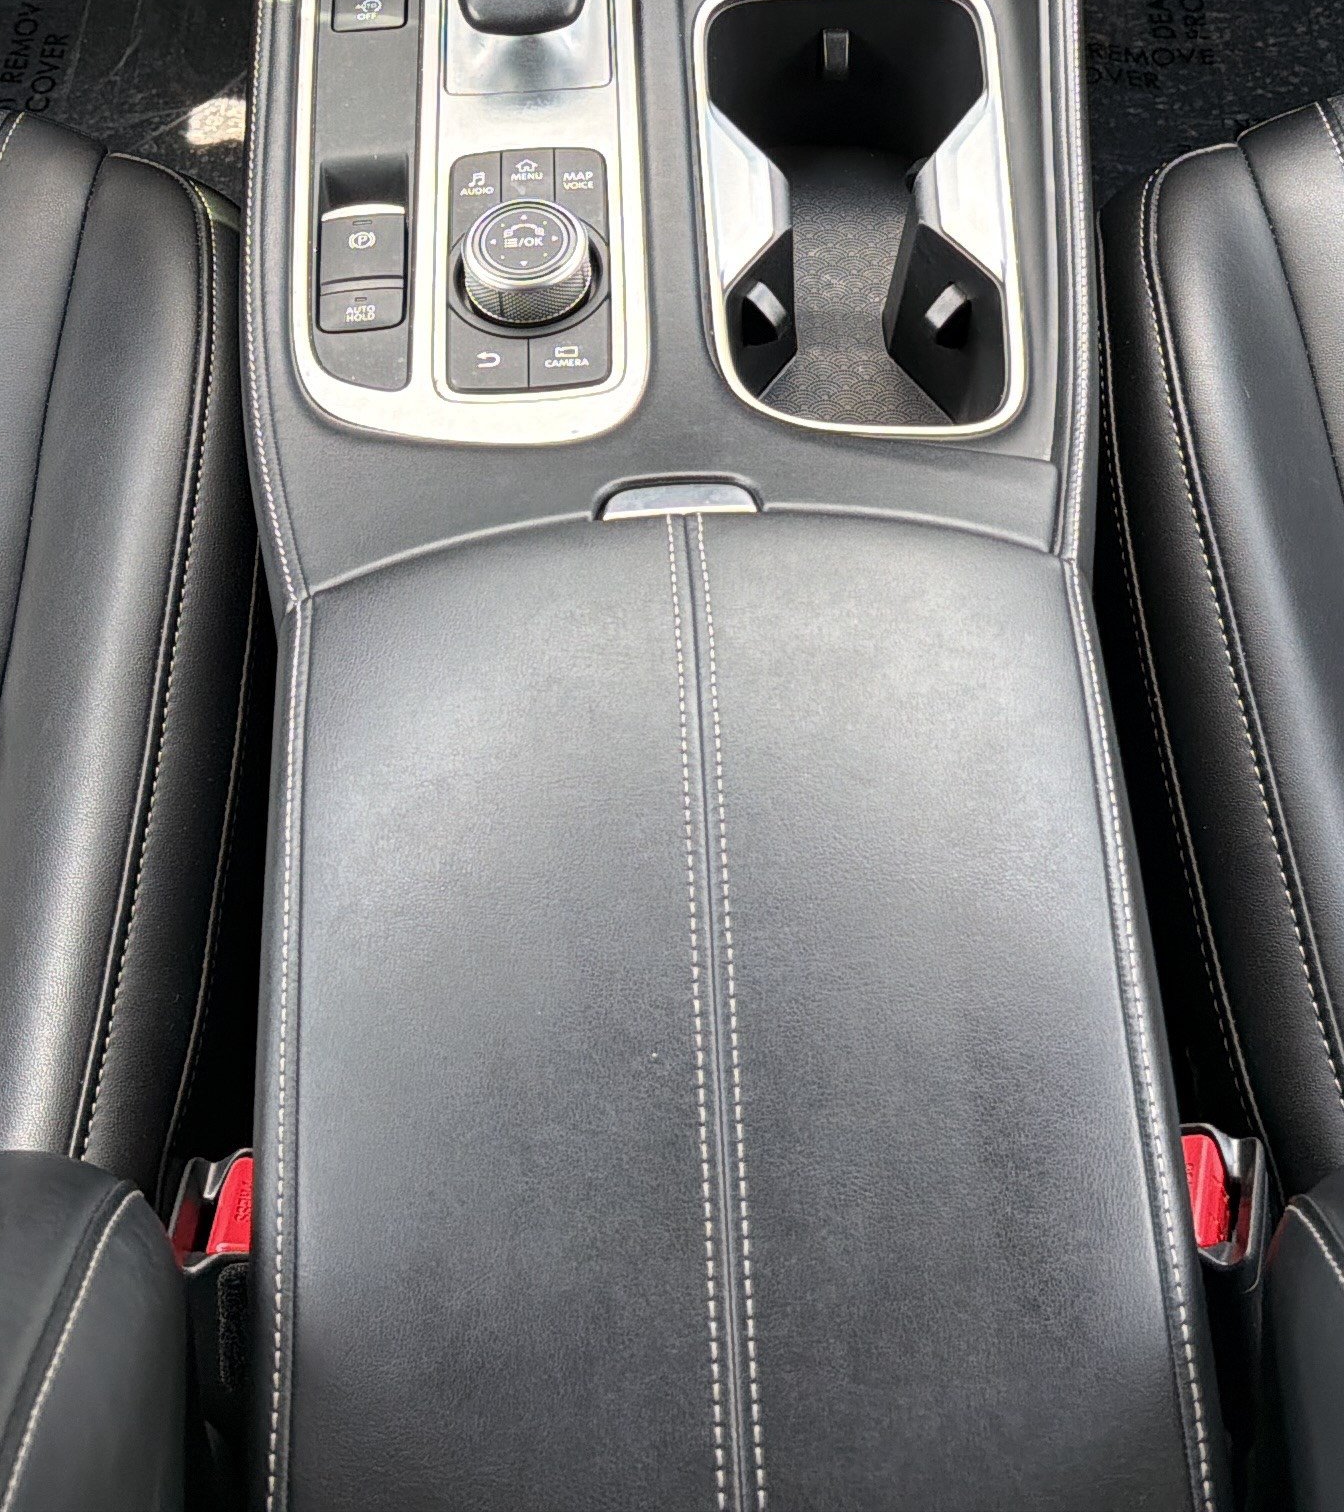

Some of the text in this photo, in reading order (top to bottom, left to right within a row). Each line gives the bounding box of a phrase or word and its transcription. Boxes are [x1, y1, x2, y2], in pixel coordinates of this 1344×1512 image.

[356, 12, 378, 21] OFF
[25, 33, 70, 112] COVER
[510, 171, 544, 182] MENU
[562, 171, 594, 181] MAP
[459, 186, 495, 196] AUDIO
[562, 181, 594, 191] VOICE
[345, 305, 376, 314] AUTO
[345, 312, 376, 322] HOLD
[544, 357, 590, 368] CAMERA
